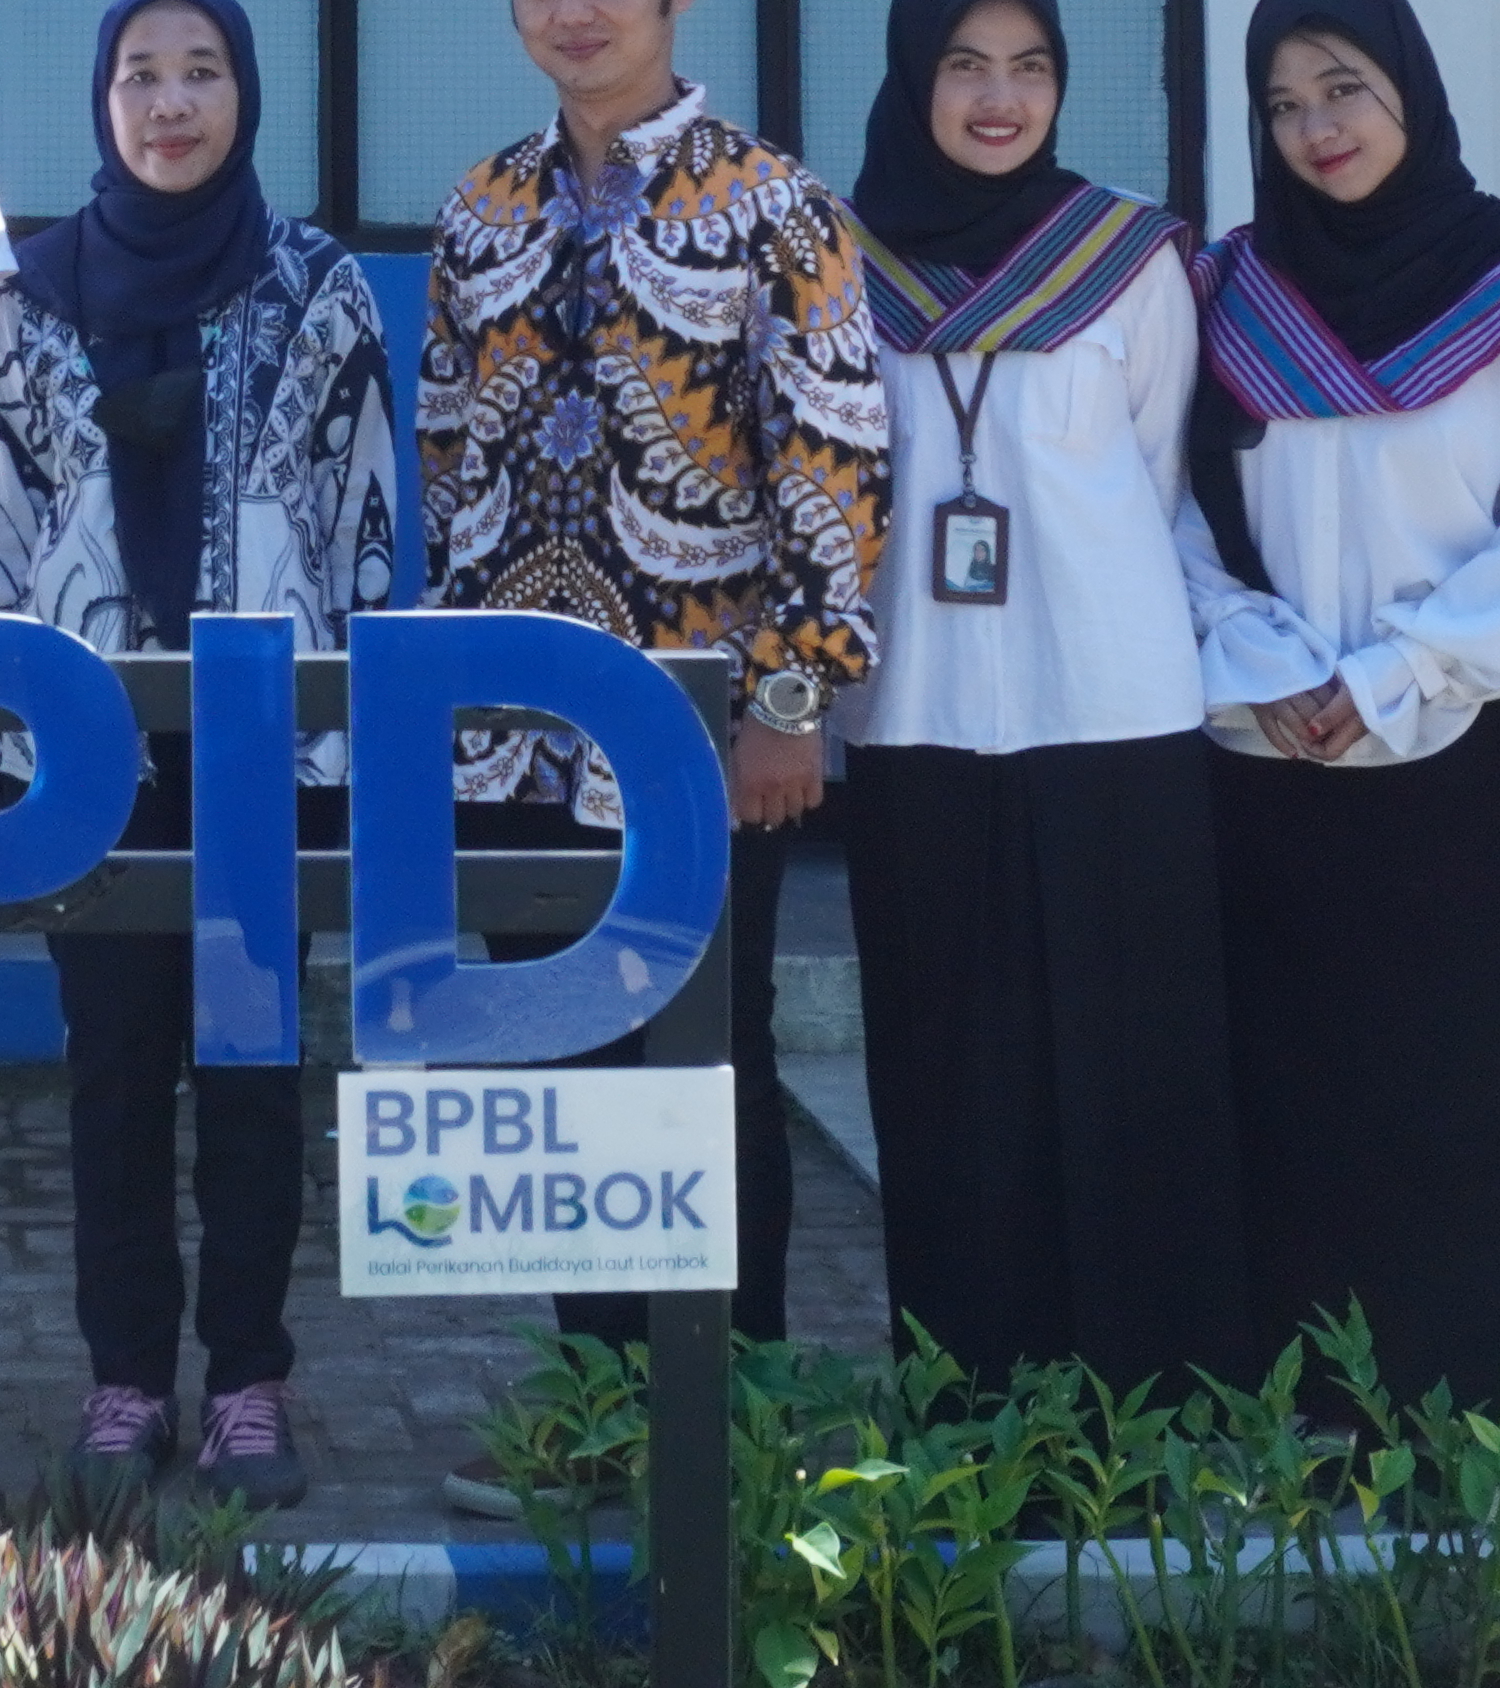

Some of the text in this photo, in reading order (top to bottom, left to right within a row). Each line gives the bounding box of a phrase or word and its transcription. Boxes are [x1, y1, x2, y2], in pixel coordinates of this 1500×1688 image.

[365, 1086, 579, 1157] BPBL
[366, 1170, 708, 1248] LOMBOK
[368, 1252, 709, 1276] Balai Perikanan Budidaya Laut Lombok
